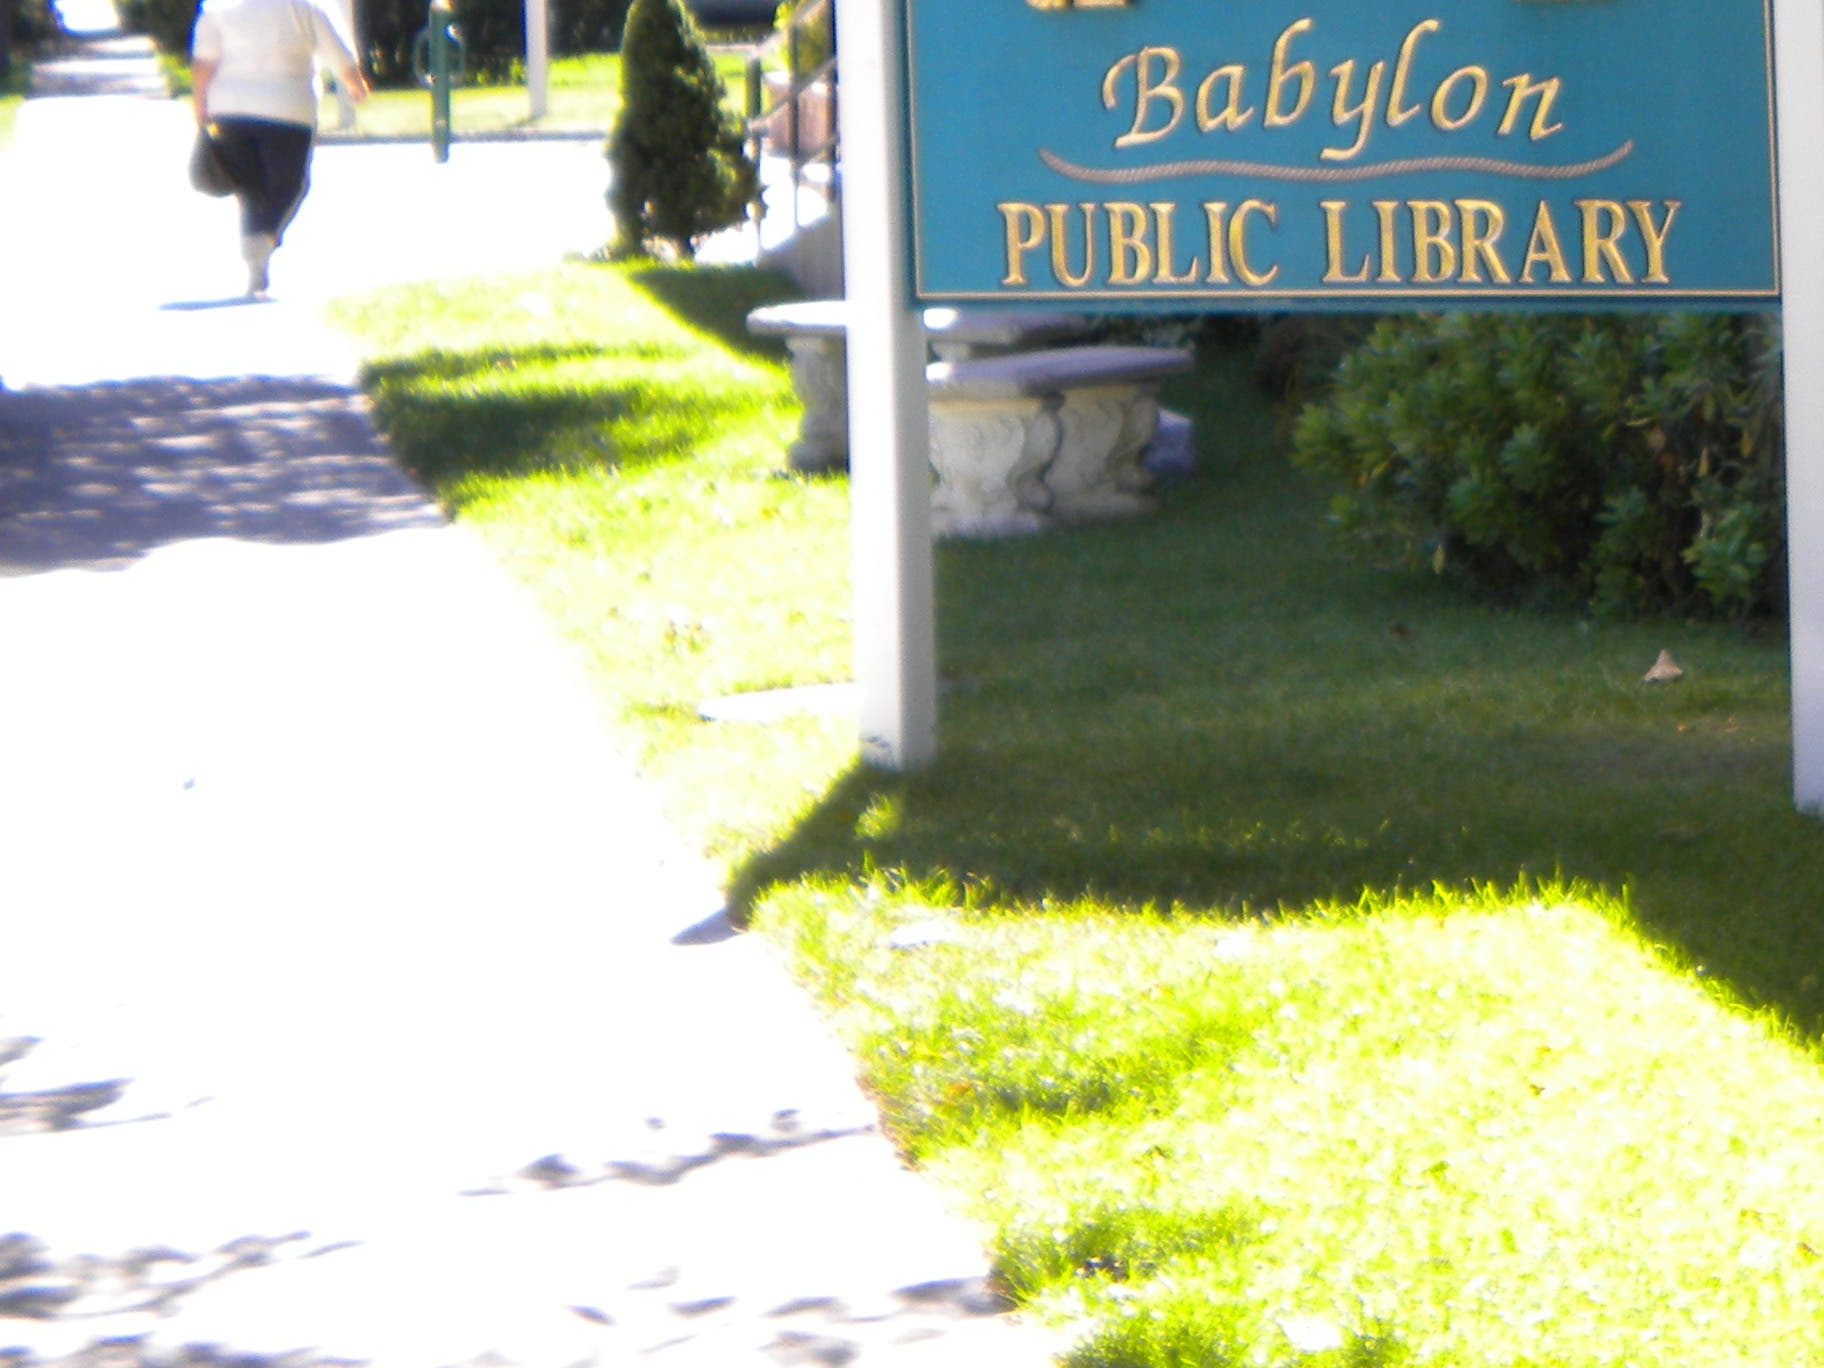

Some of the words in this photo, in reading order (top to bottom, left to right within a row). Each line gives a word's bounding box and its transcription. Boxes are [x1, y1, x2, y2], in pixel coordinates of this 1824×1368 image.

[1102, 18, 1563, 160] Babylon
[998, 199, 1278, 286] PUBLIC
[1320, 199, 1681, 284] LIBRARY
